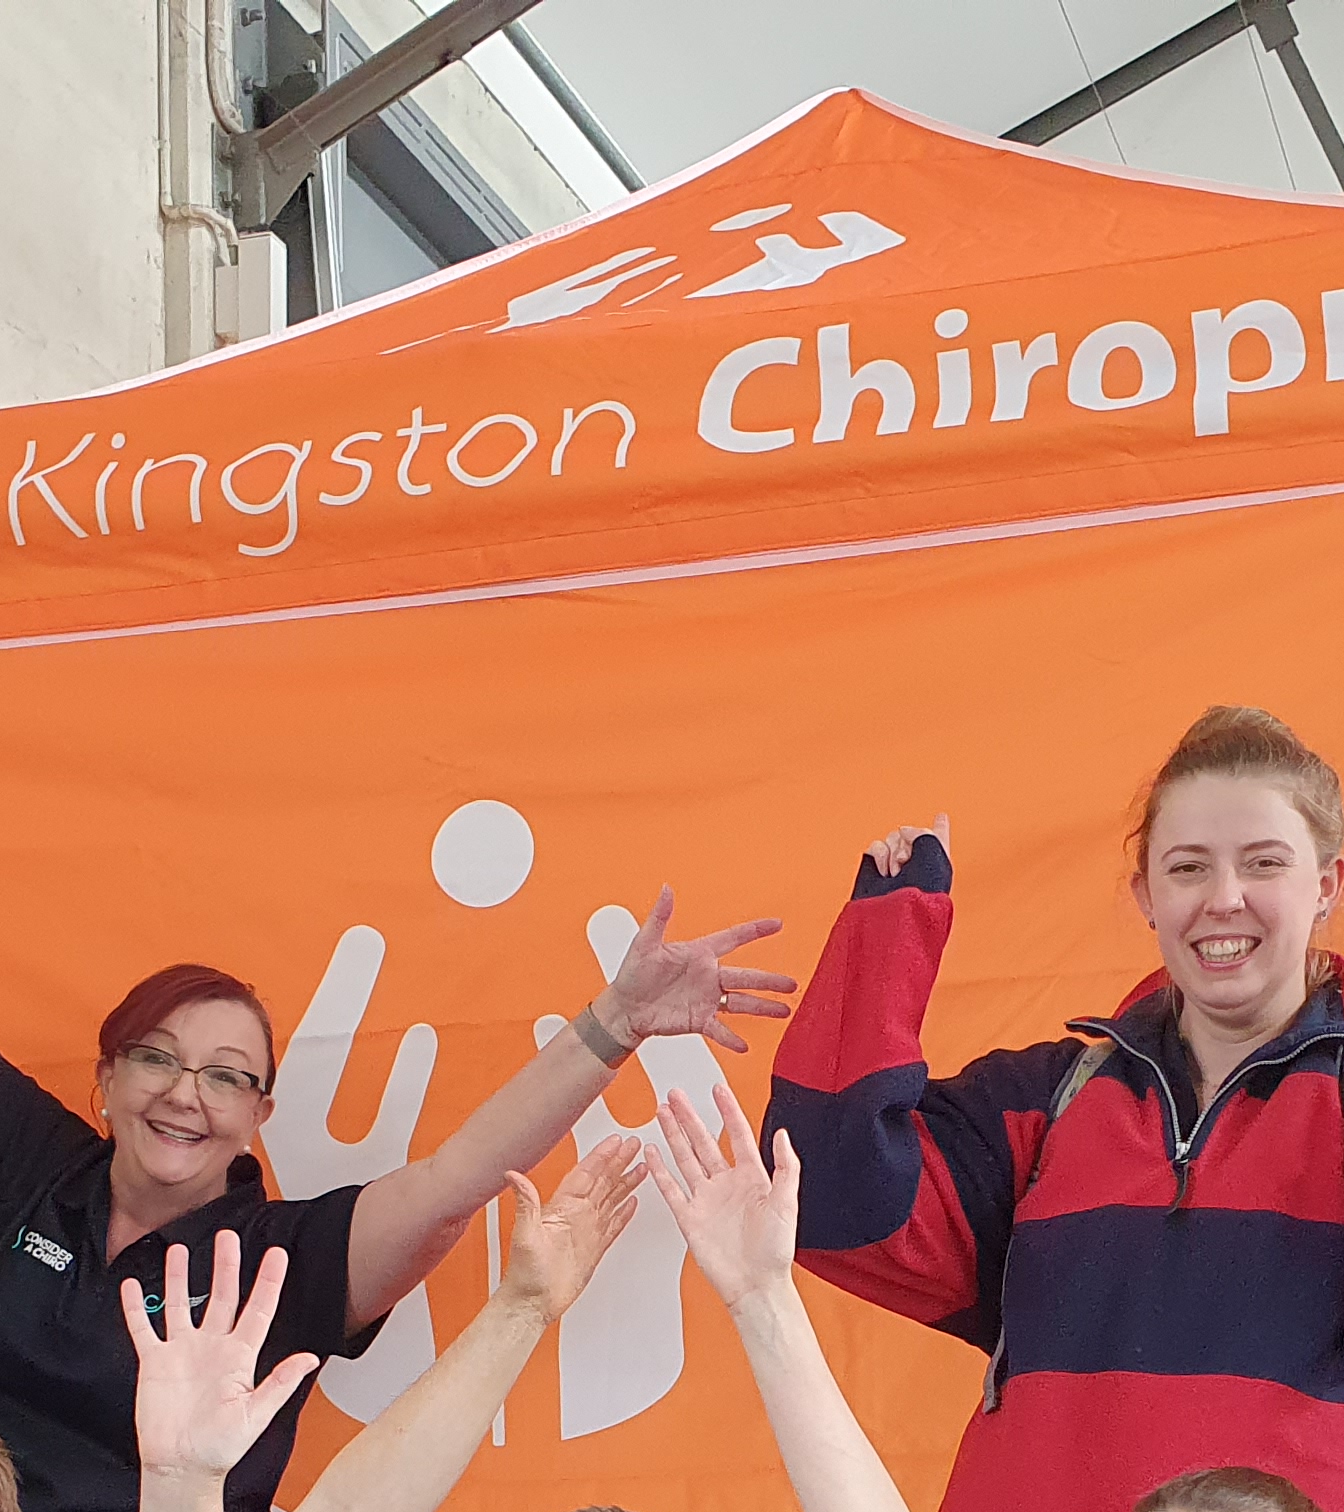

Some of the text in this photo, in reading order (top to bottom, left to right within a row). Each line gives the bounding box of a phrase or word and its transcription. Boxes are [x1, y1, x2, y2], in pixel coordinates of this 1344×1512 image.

[7, 400, 637, 557] Kingston
[23, 1243, 66, 1272] A CHIRO
[24, 1231, 74, 1265] CONSIDER
